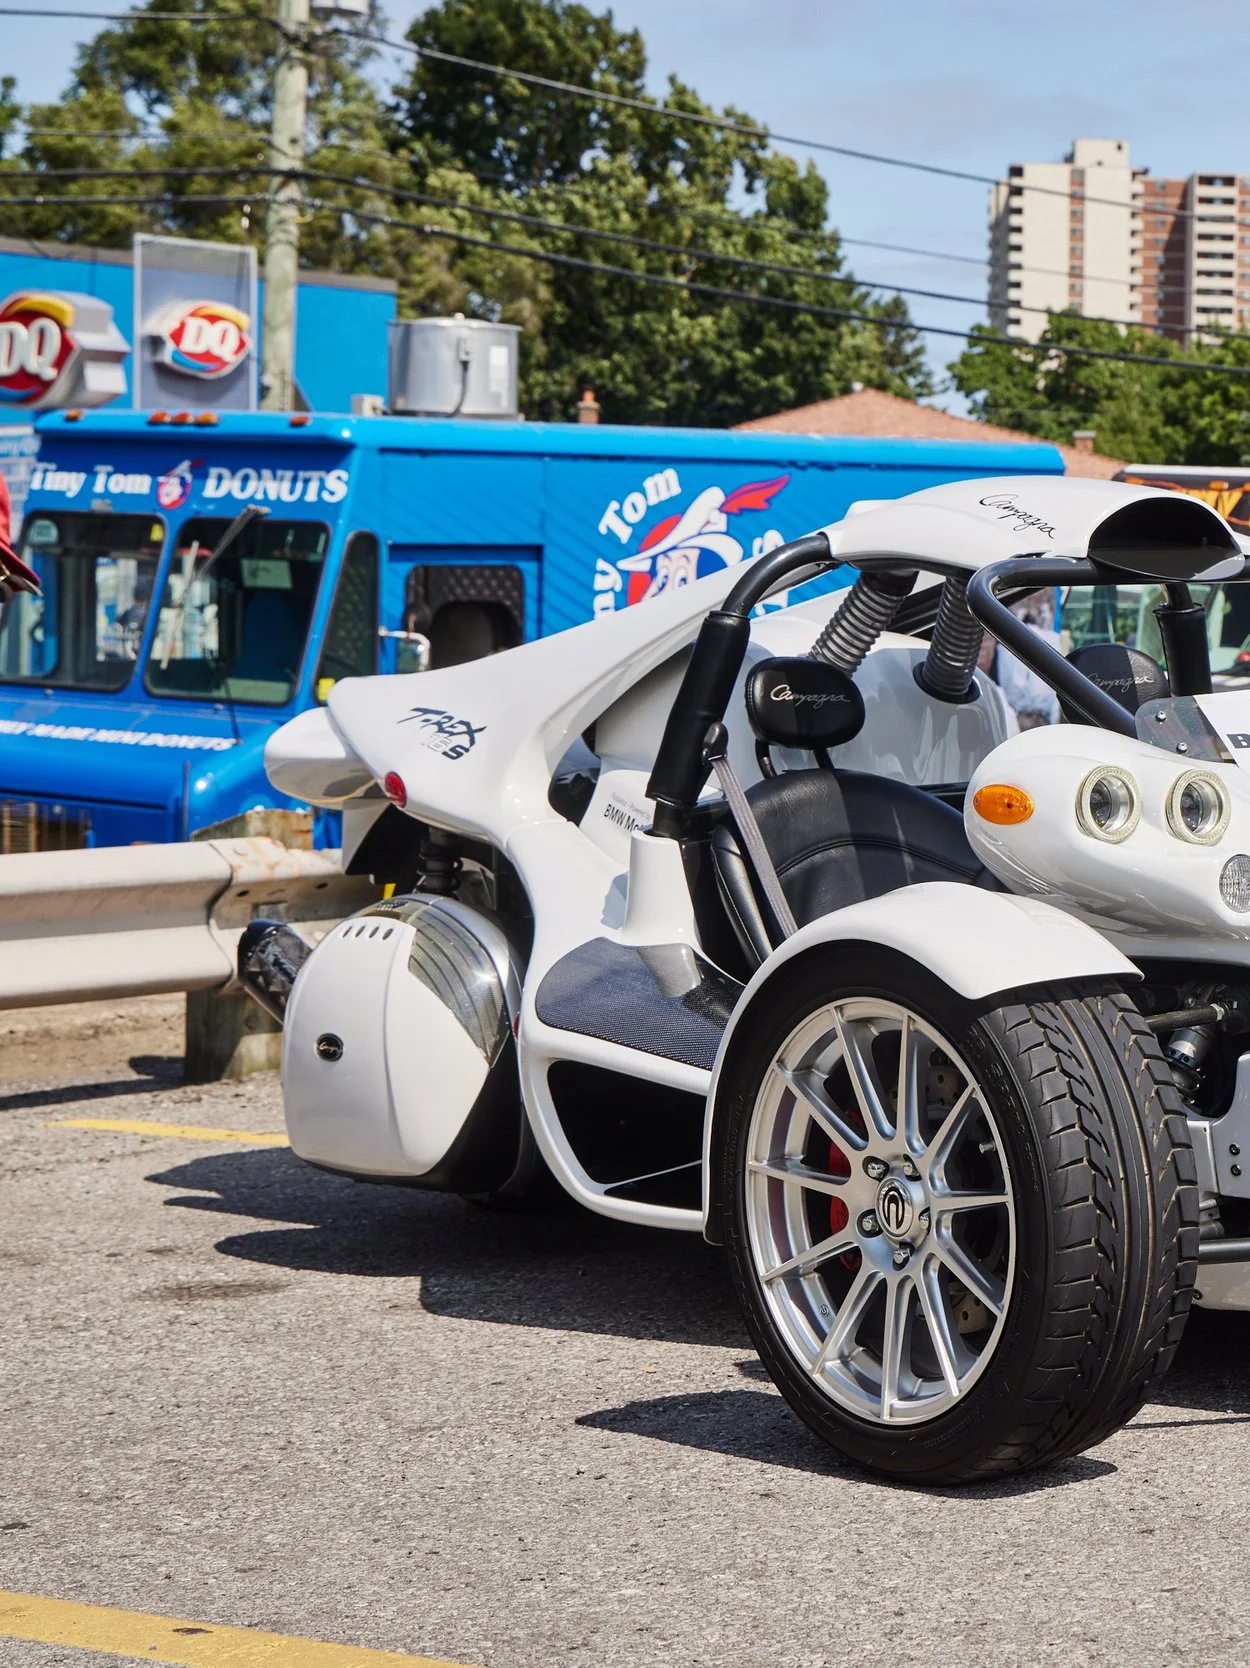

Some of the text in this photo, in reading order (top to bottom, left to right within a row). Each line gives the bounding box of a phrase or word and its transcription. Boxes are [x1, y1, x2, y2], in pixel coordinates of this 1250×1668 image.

[180, 316, 238, 363] DQ
[30, 462, 349, 503] Tiny Tom DONUTS
[598, 468, 682, 544] Tom
[979, 493, 1056, 539] Campagna
[396, 707, 487, 747] T-REX
